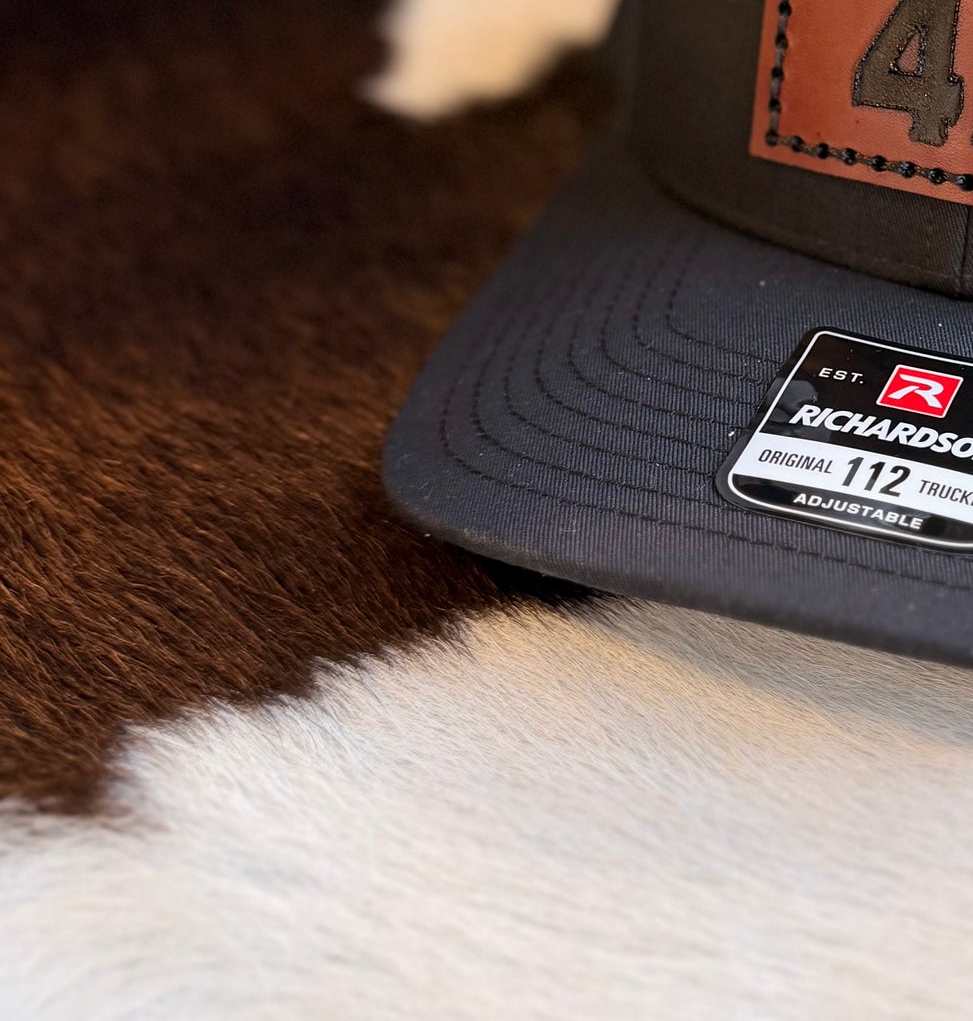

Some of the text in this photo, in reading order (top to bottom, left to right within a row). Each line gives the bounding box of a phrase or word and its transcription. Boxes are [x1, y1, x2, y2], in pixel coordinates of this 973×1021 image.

[818, 367, 864, 384] EST.
[758, 449, 833, 475] ORIGINAL
[841, 456, 912, 498] 112
[793, 492, 925, 530] ADJUSTABLE
